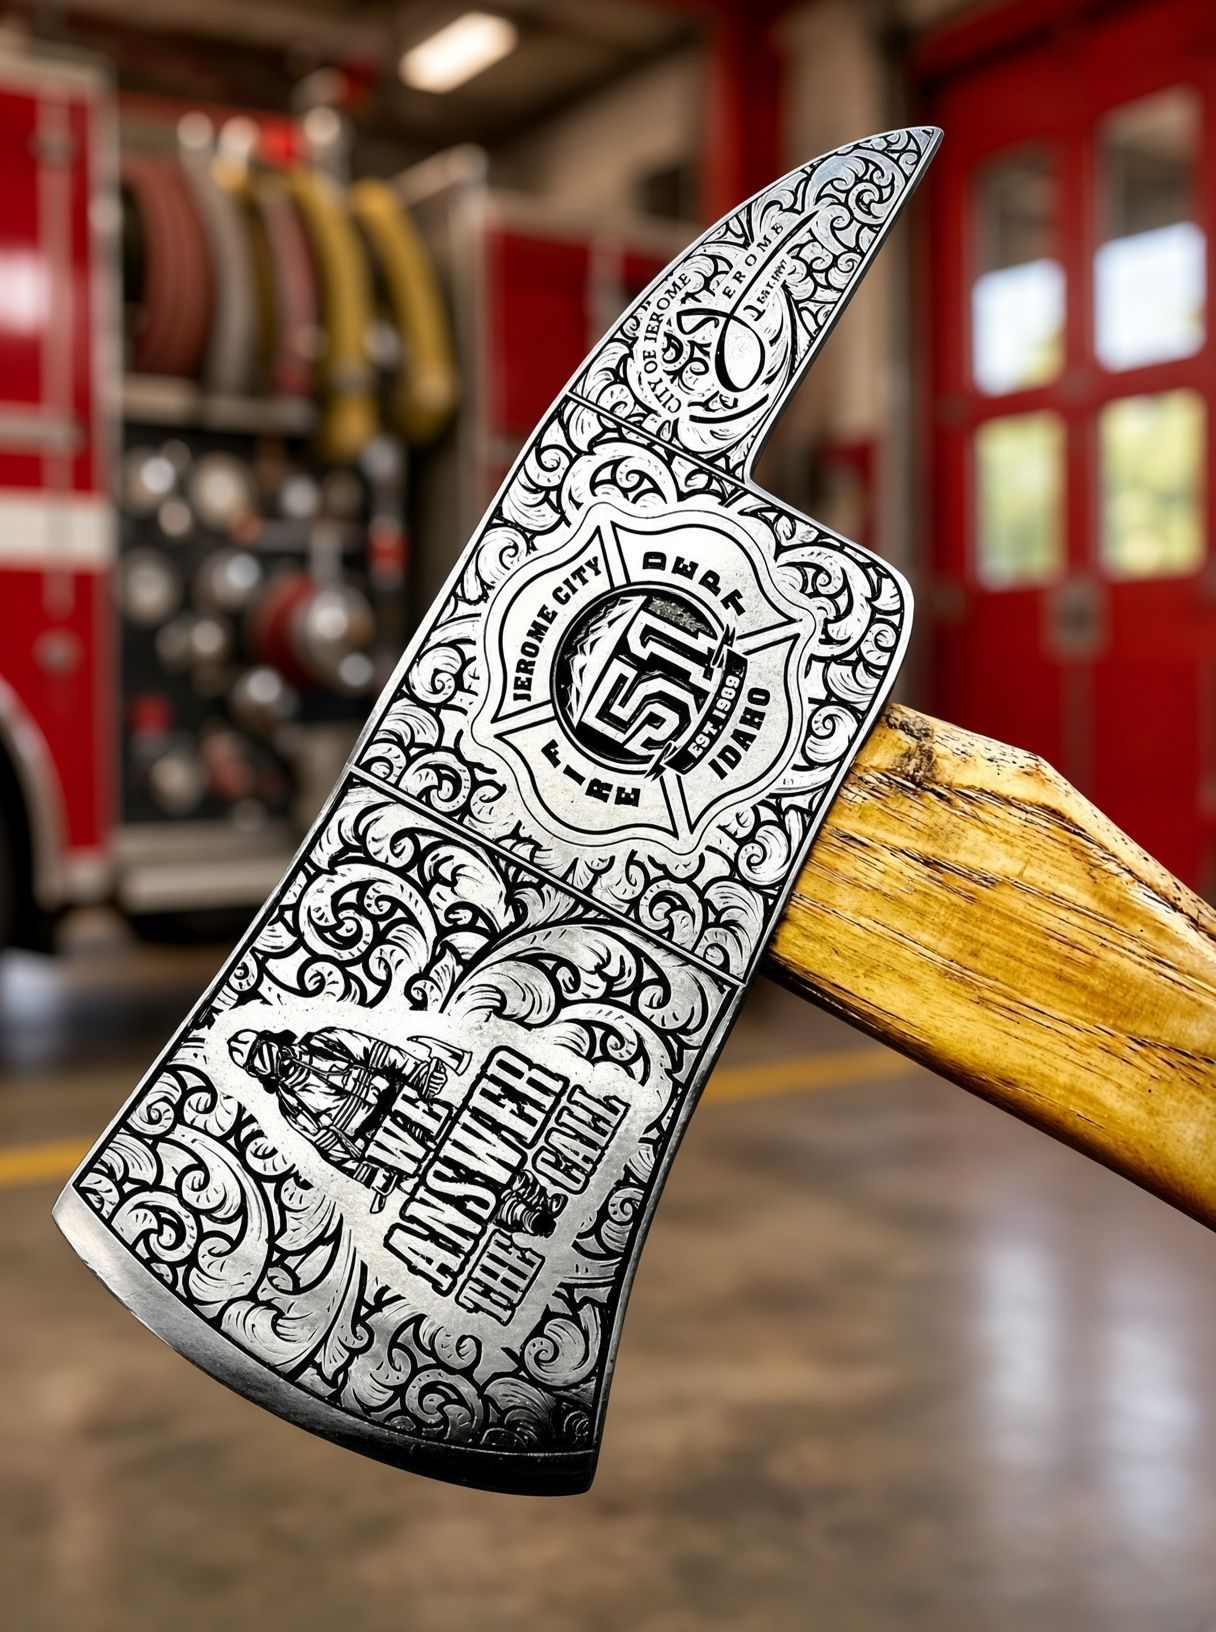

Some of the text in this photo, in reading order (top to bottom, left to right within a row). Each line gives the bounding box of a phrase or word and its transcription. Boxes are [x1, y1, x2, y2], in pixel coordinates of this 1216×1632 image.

[647, 377, 682, 414] CITY
[513, 556, 602, 702] JEROME CITY
[642, 551, 745, 616] DEPT
[580, 608, 718, 757] 51
[541, 739, 641, 808] FIRE
[708, 687, 771, 780] IDAHO
[364, 1085, 451, 1176] WE
[384, 1046, 570, 1296] ANSWER
[455, 1084, 632, 1327] THE CALL
